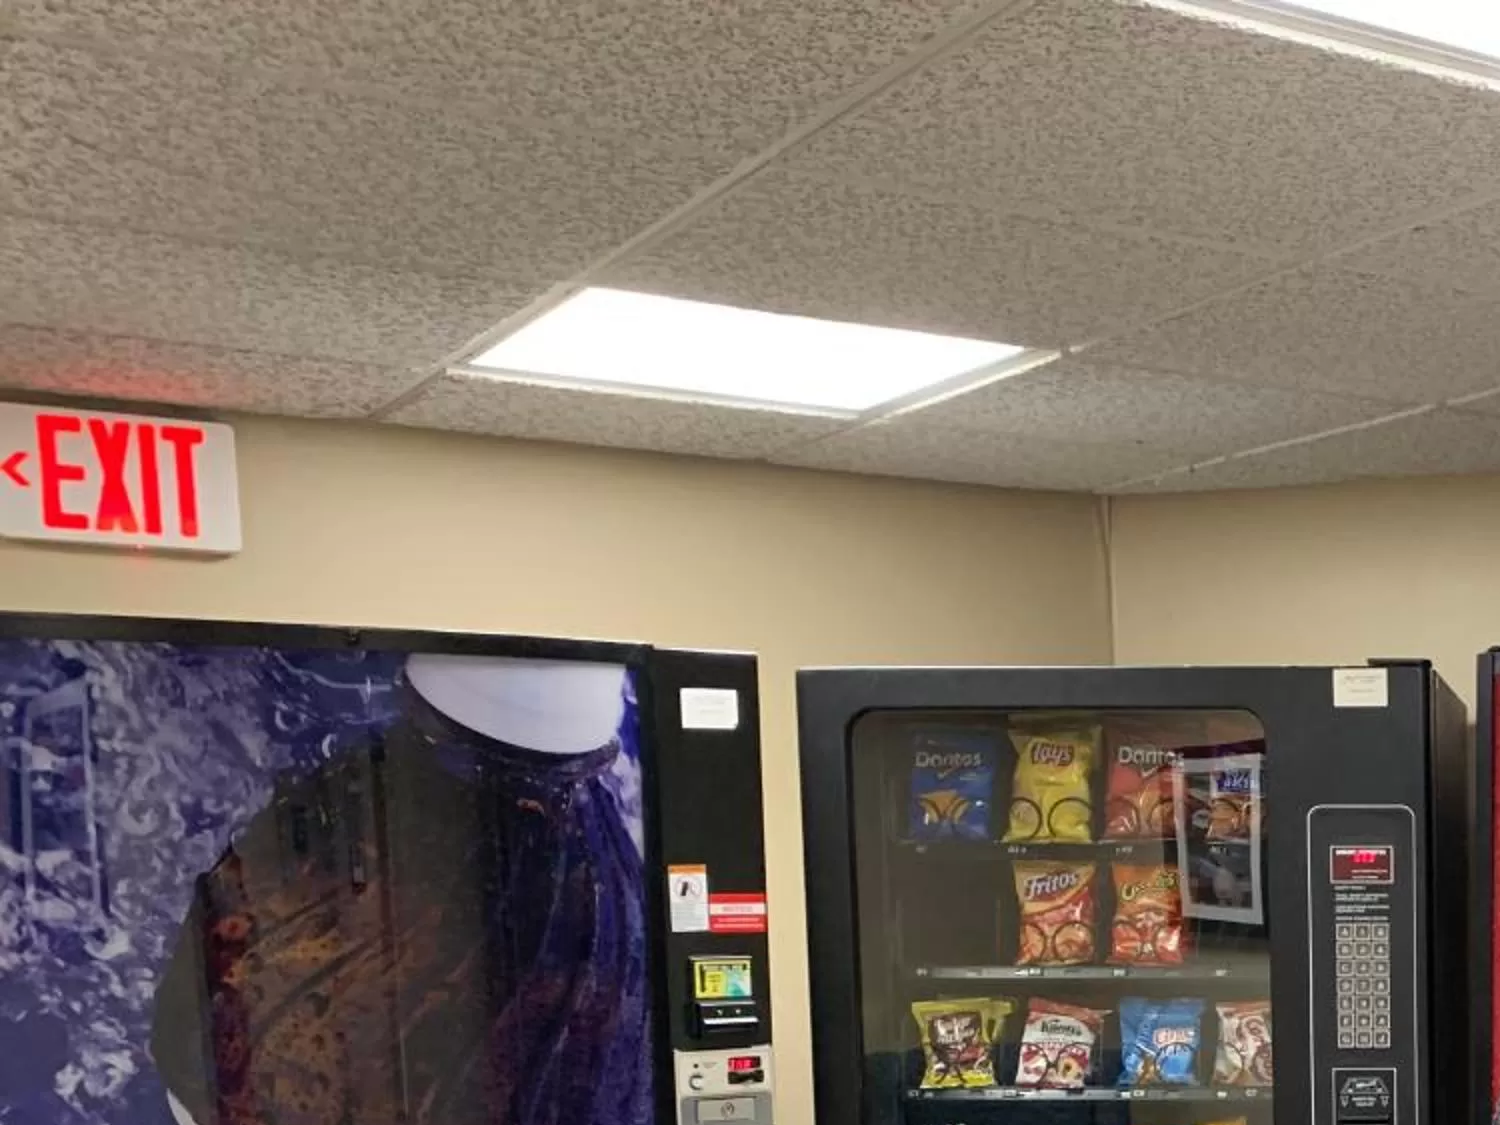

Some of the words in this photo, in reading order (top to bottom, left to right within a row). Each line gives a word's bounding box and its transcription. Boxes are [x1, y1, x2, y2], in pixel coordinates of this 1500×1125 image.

[36, 414, 205, 537] EXIT
[914, 751, 983, 768] Doritos
[1032, 743, 1074, 766] Lay's
[1118, 746, 1184, 768] Doritos
[1024, 872, 1079, 899] Fritos
